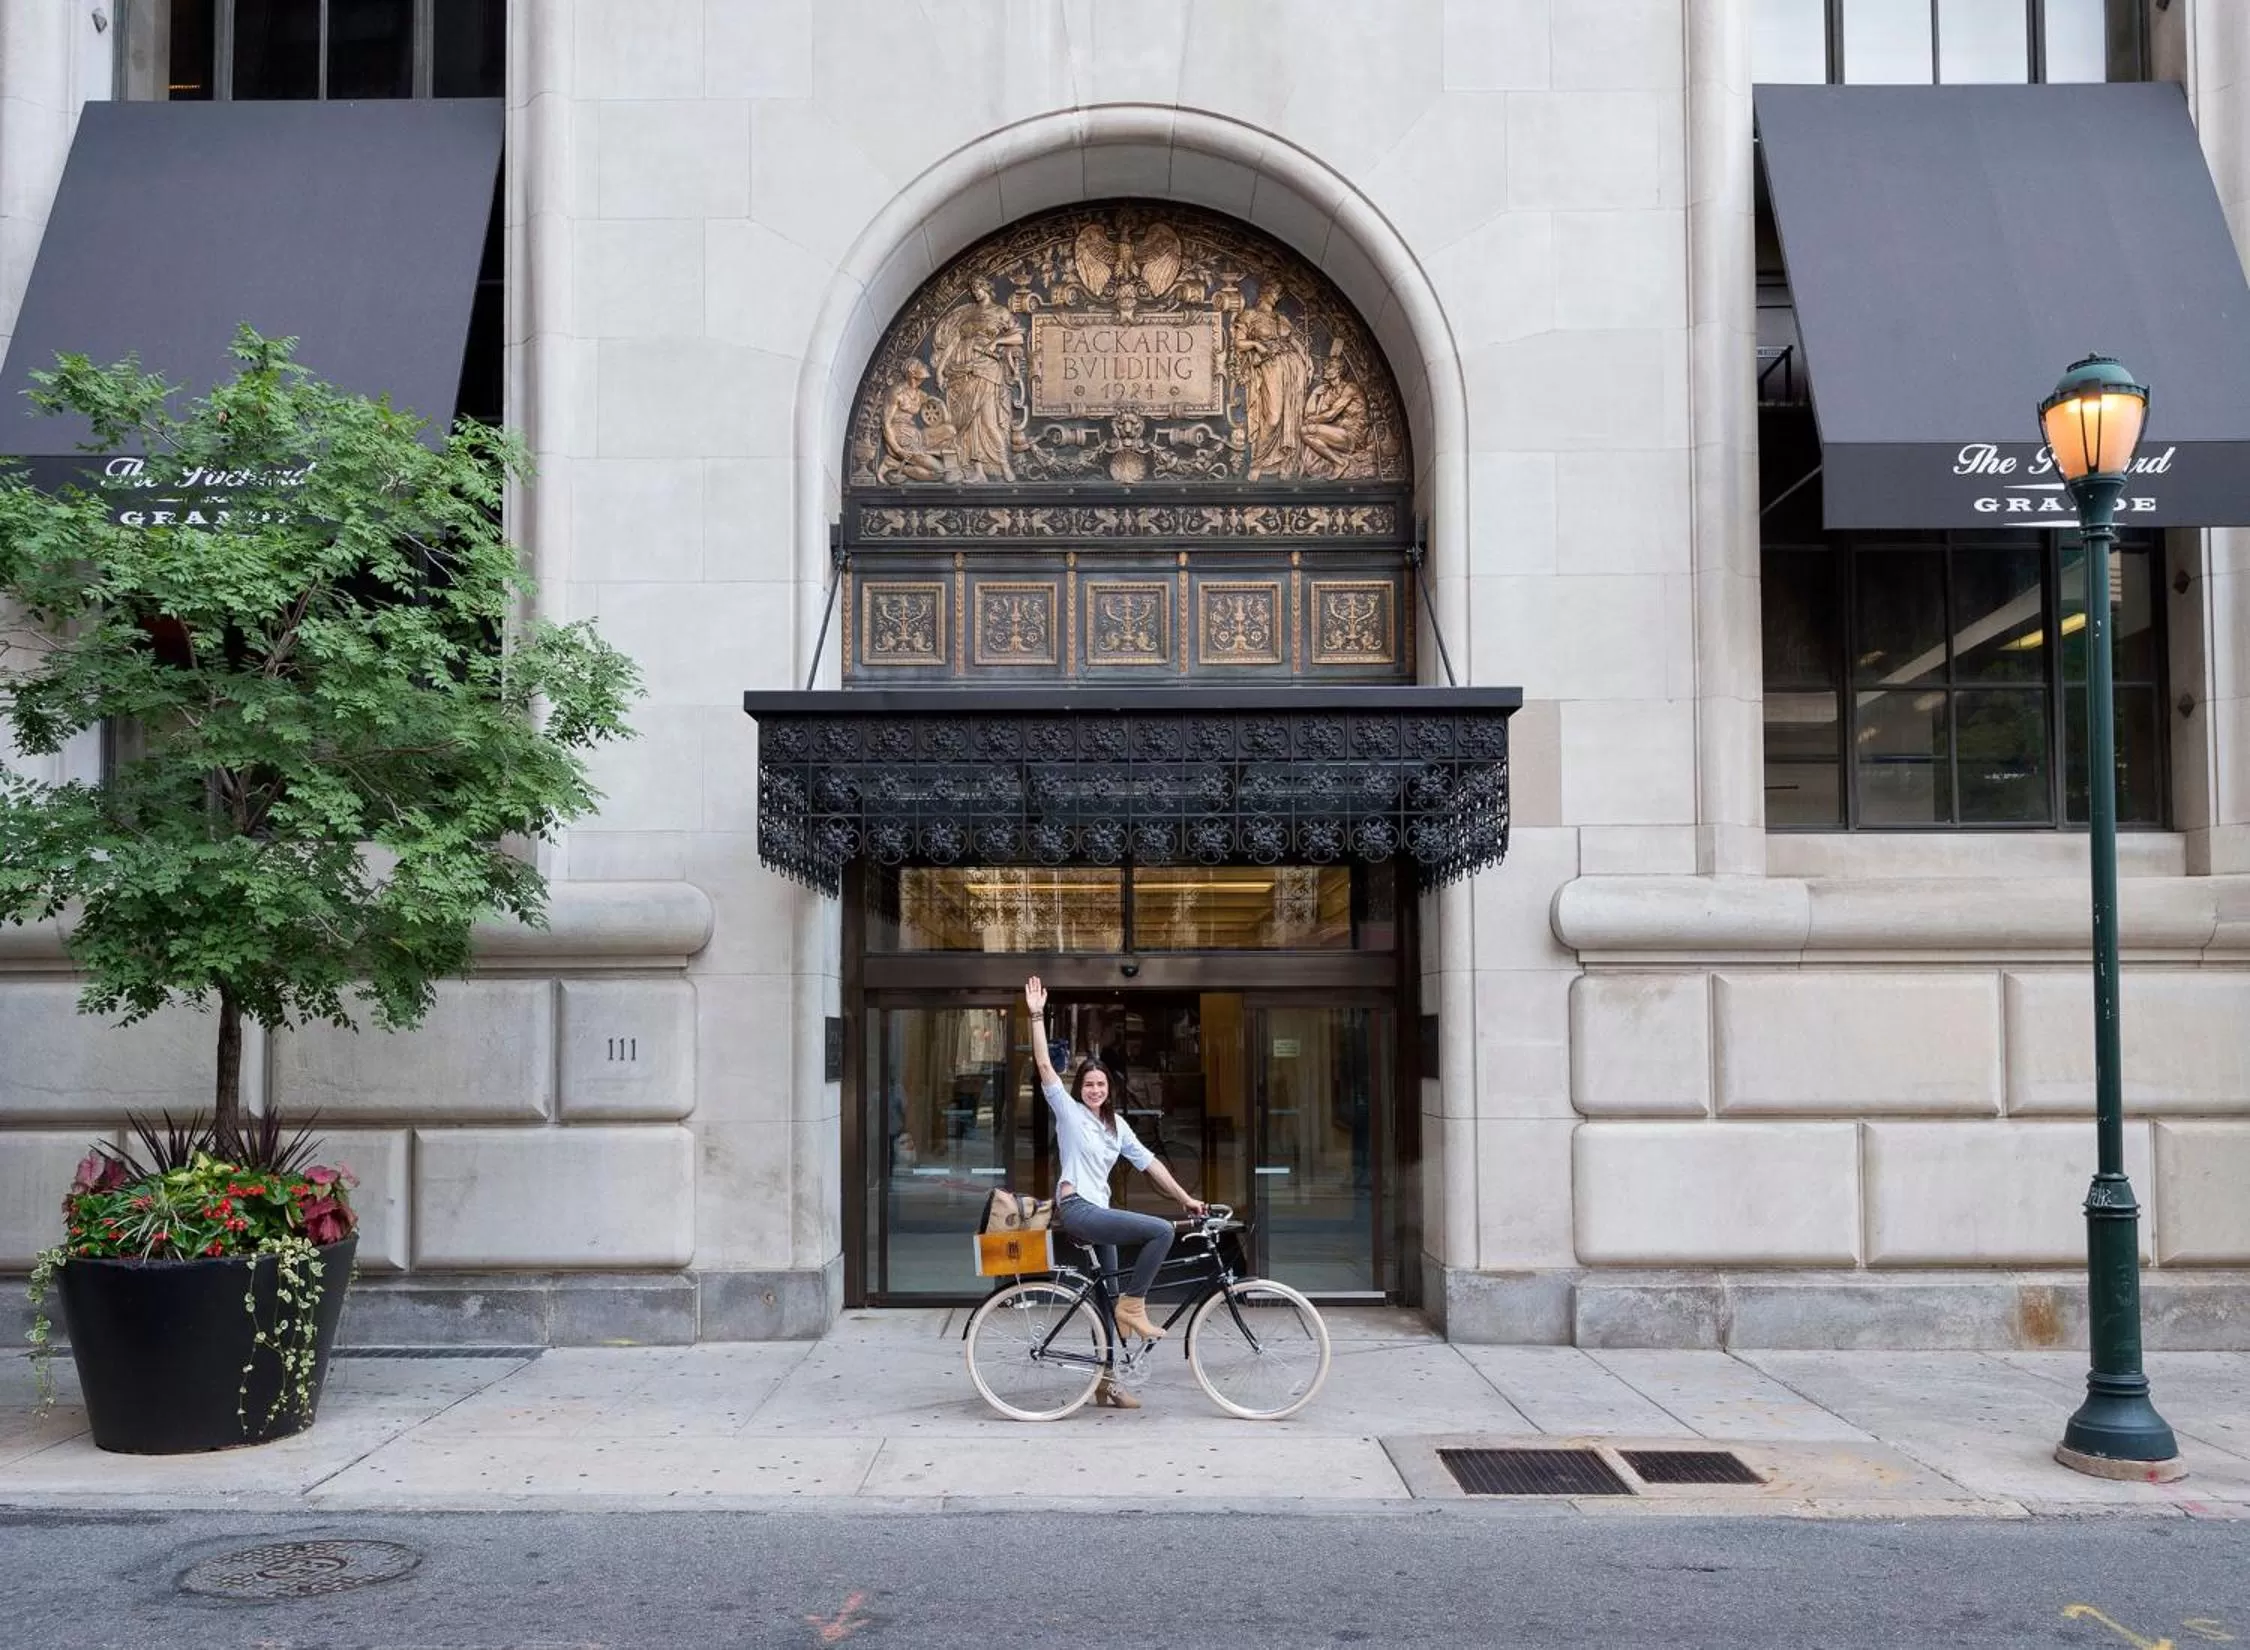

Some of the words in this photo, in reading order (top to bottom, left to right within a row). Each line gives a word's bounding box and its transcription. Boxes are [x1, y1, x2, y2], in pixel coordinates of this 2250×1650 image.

[1062, 331, 1193, 353] PACKARD
[1063, 357, 1193, 380] BVILDING
[1101, 383, 1156, 400] 1924
[1953, 443, 2017, 475] The
[1973, 497, 2156, 512] GRADE
[608, 1037, 636, 1061] 111
